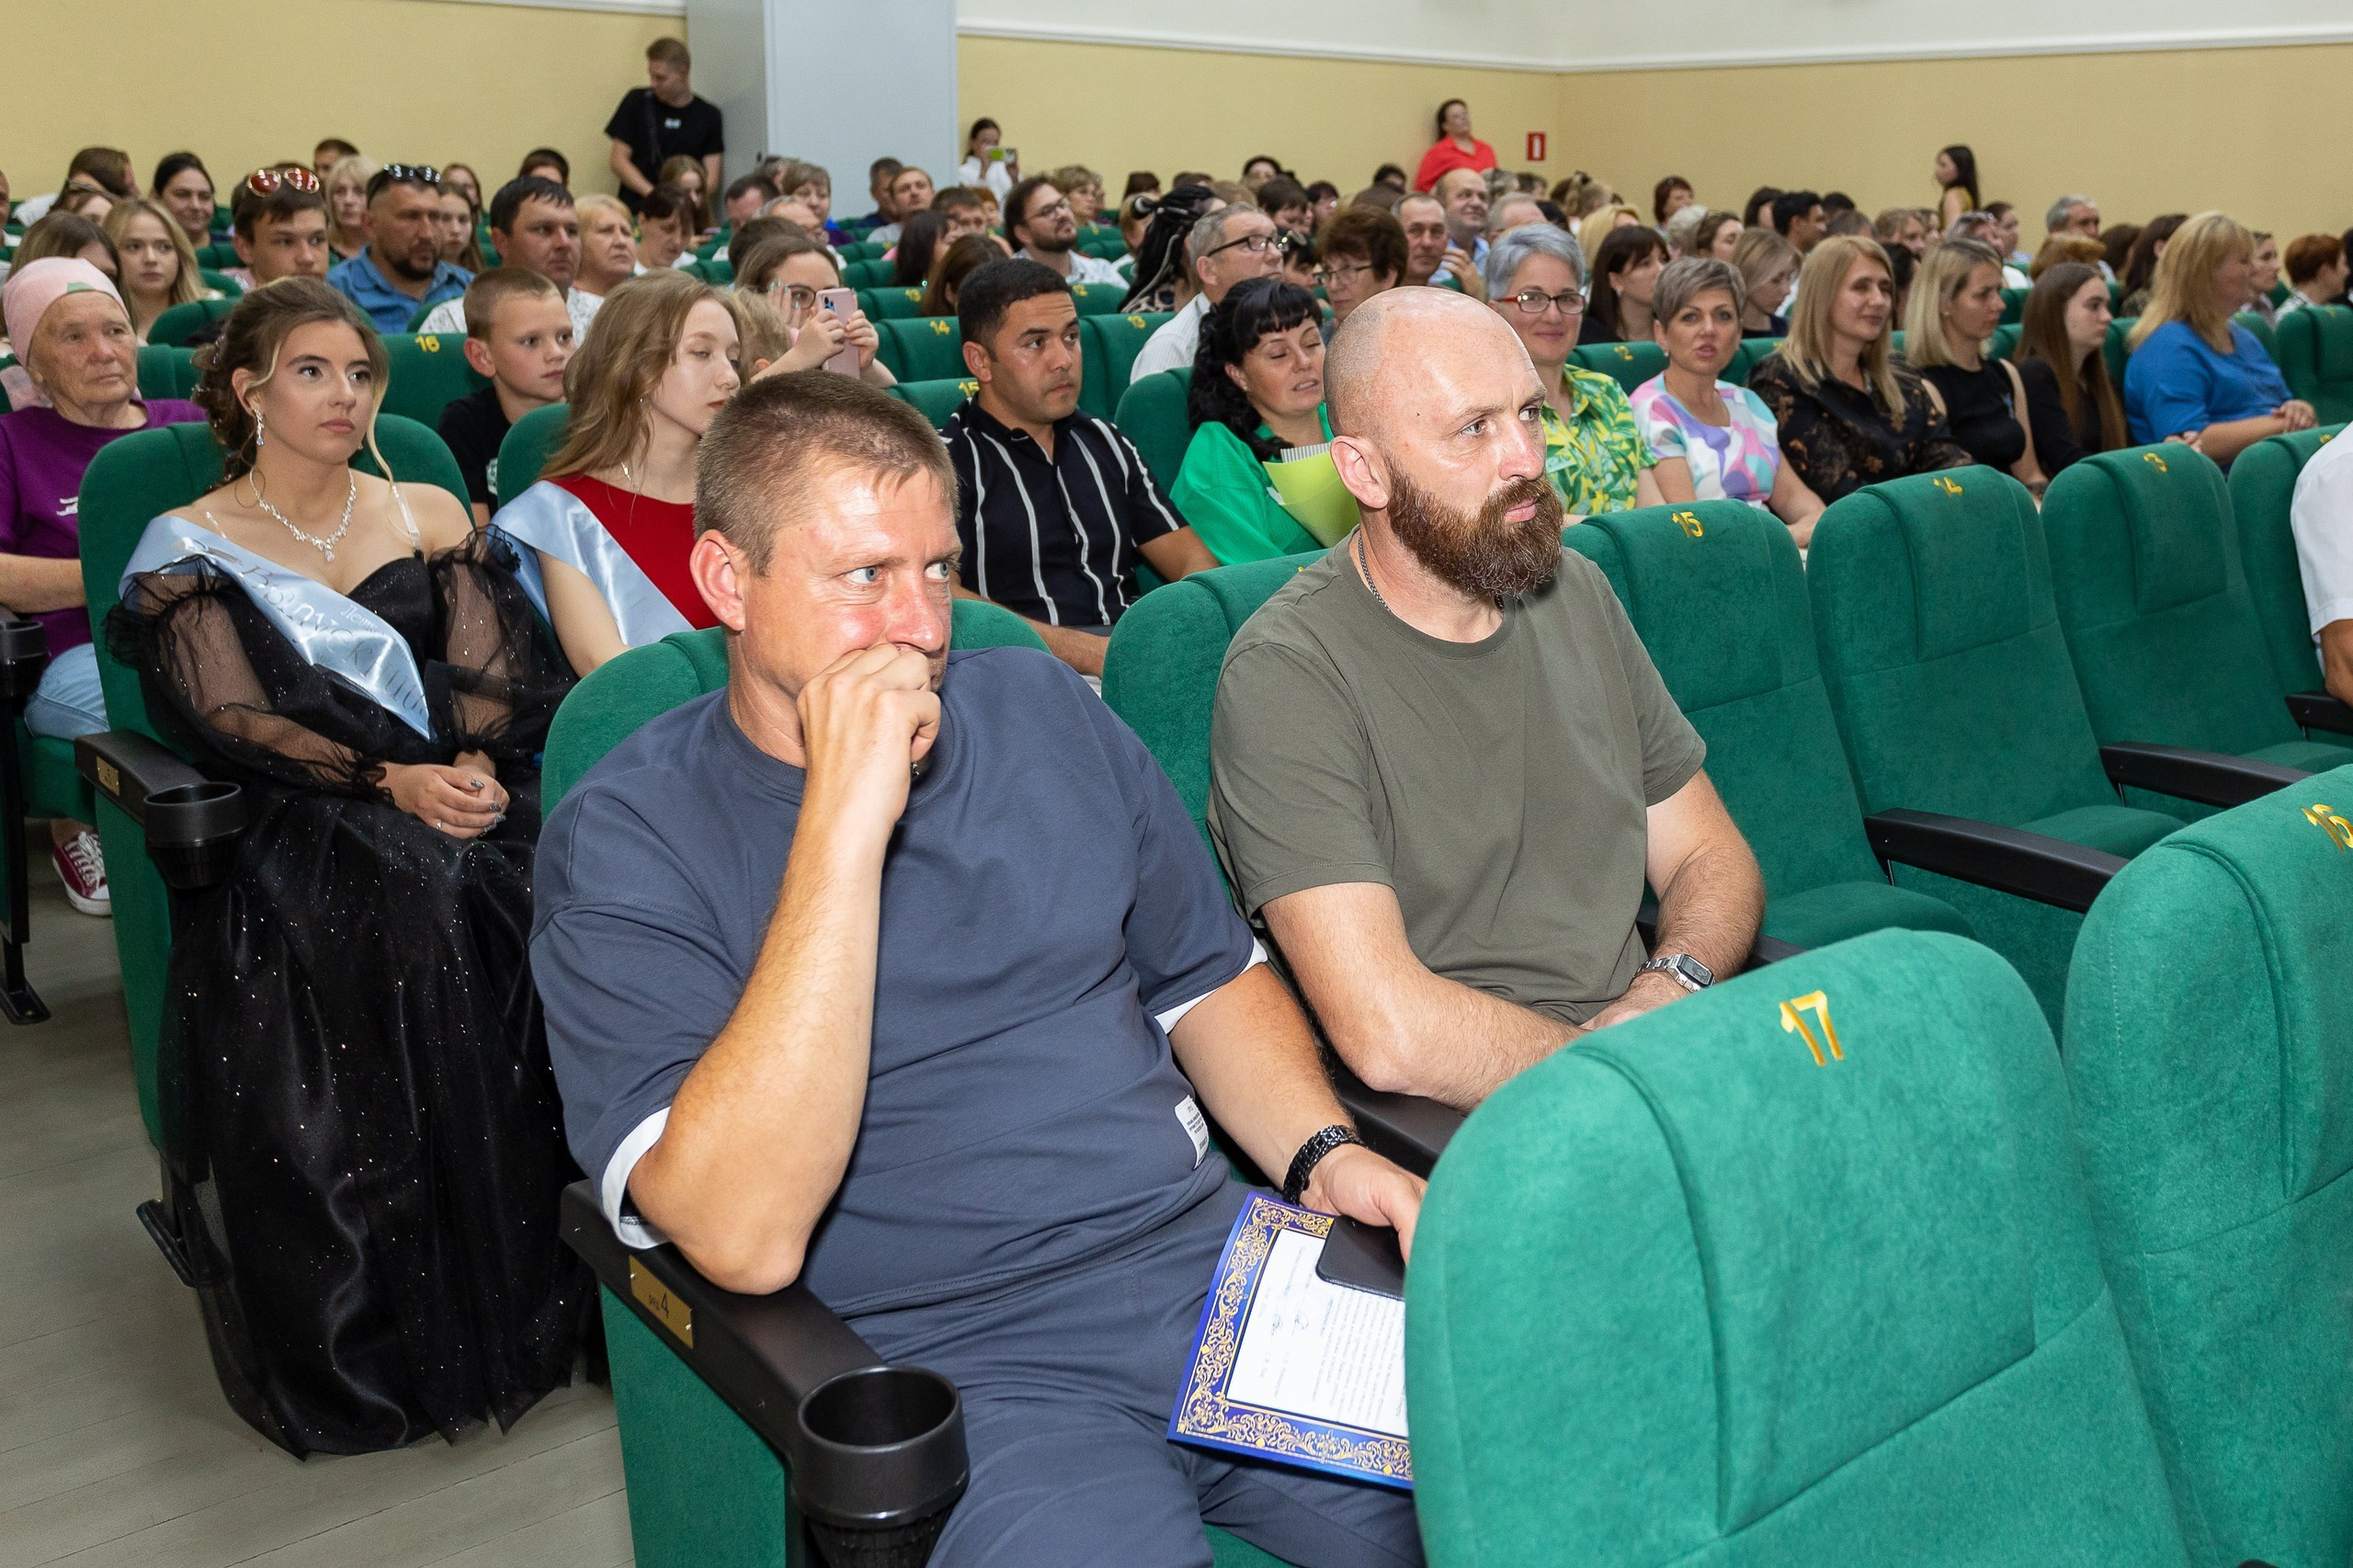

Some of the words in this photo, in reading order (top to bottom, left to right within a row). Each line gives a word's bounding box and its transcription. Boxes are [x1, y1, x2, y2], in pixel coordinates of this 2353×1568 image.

[929, 320, 950, 335] 14
[415, 335, 440, 353] 16
[1932, 476, 1963, 498] 14
[1672, 511, 1704, 539] 15
[2301, 803, 2353, 852] 16
[1779, 989, 1845, 1067] 17
[660, 1290, 670, 1319] 4
